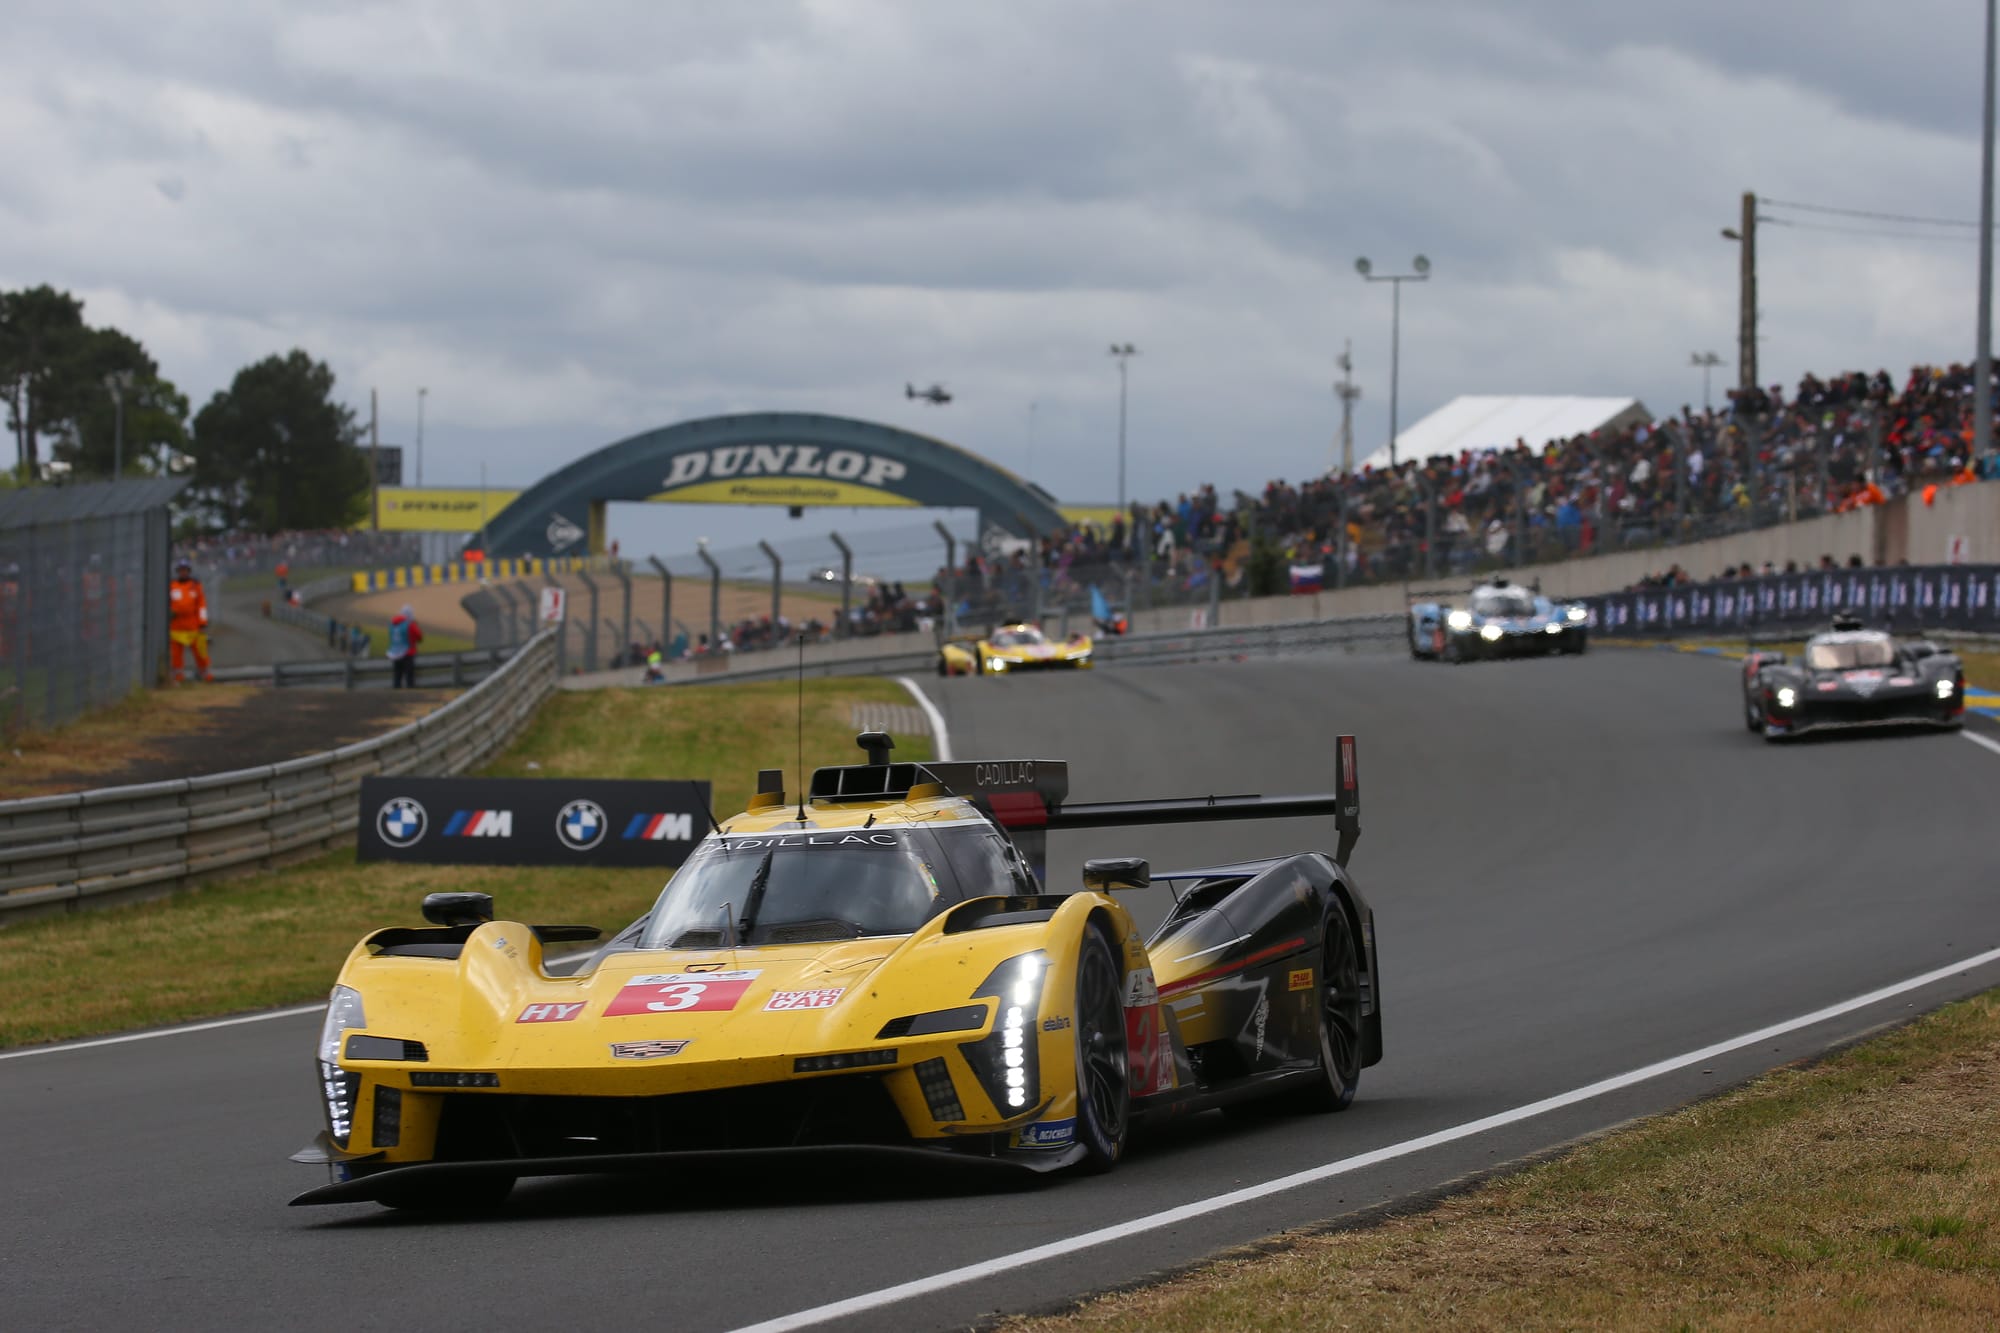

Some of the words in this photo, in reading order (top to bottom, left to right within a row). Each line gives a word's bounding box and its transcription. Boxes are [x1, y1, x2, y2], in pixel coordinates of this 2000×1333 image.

[662, 445, 907, 486] DUNLOP
[976, 762, 1034, 786] CADILLAC
[695, 832, 898, 856] CADILLAC
[647, 983, 707, 1011] 3
[769, 995, 837, 1009] CAR
[776, 988, 843, 999] HYPER
[520, 1004, 583, 1021] HY
[1130, 1010, 1151, 1091] 3
